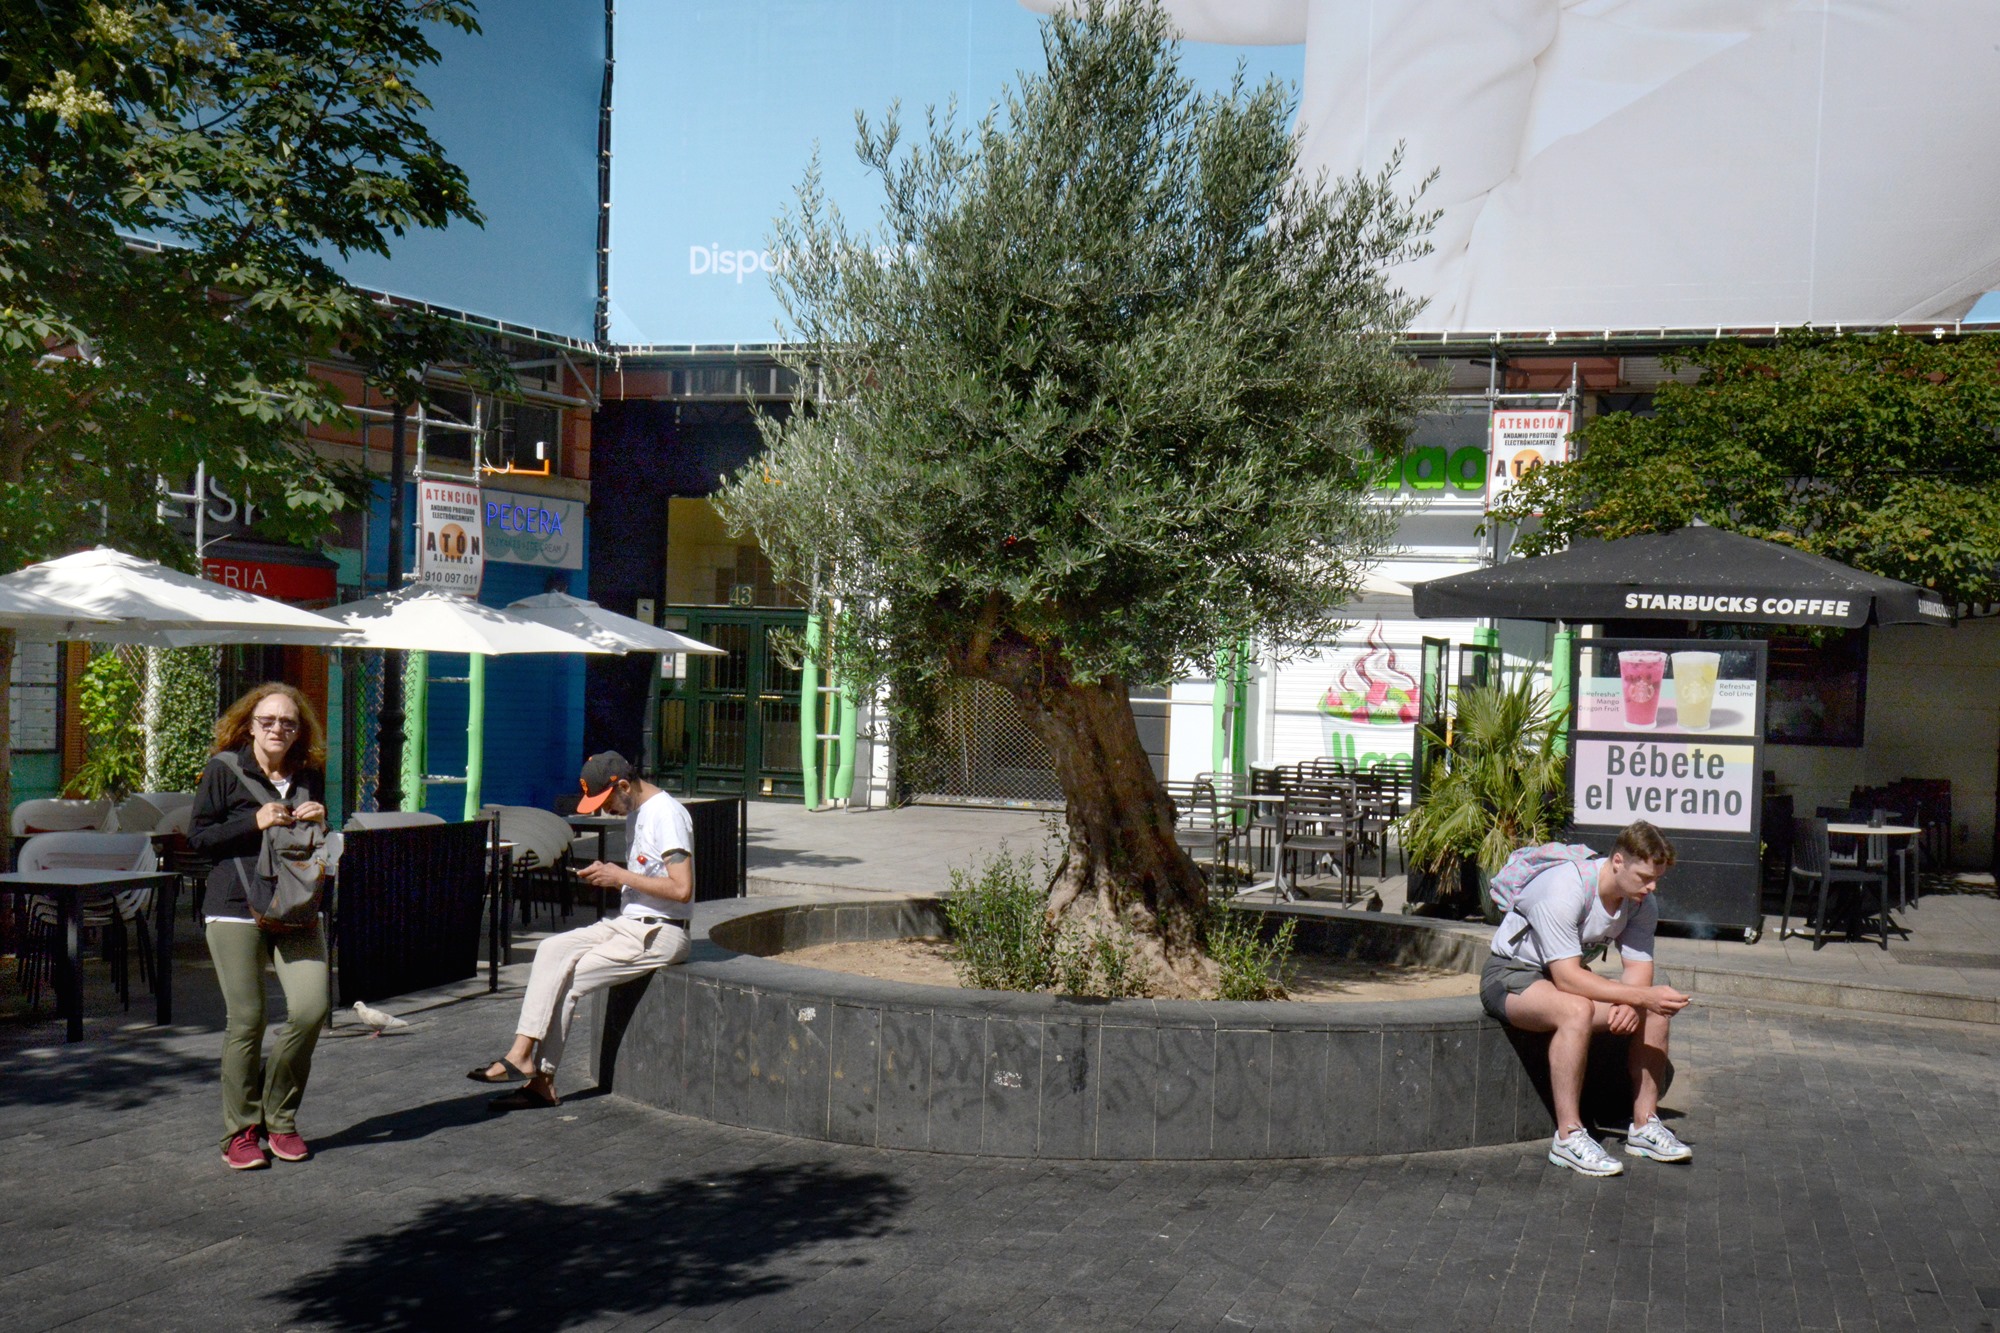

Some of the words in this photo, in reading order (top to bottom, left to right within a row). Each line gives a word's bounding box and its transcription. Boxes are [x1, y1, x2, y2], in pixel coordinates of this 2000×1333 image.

[1499, 416, 1564, 429] ATENCIÓN
[426, 488, 478, 506] ATENCIÓN
[486, 502, 563, 537] PECERA
[427, 531, 480, 556] ATÓN
[434, 553, 474, 565] ALARMAS
[425, 571, 442, 582] 910
[444, 572, 461, 583] 097
[463, 574, 478, 585] 011
[729, 586, 752, 605] 43
[1625, 593, 1757, 613] STARBUCKS
[1762, 598, 1850, 617] COFFEE
[1607, 743, 1724, 780] Bébete
[1585, 778, 1613, 810] el
[1626, 786, 1742, 816] verano
